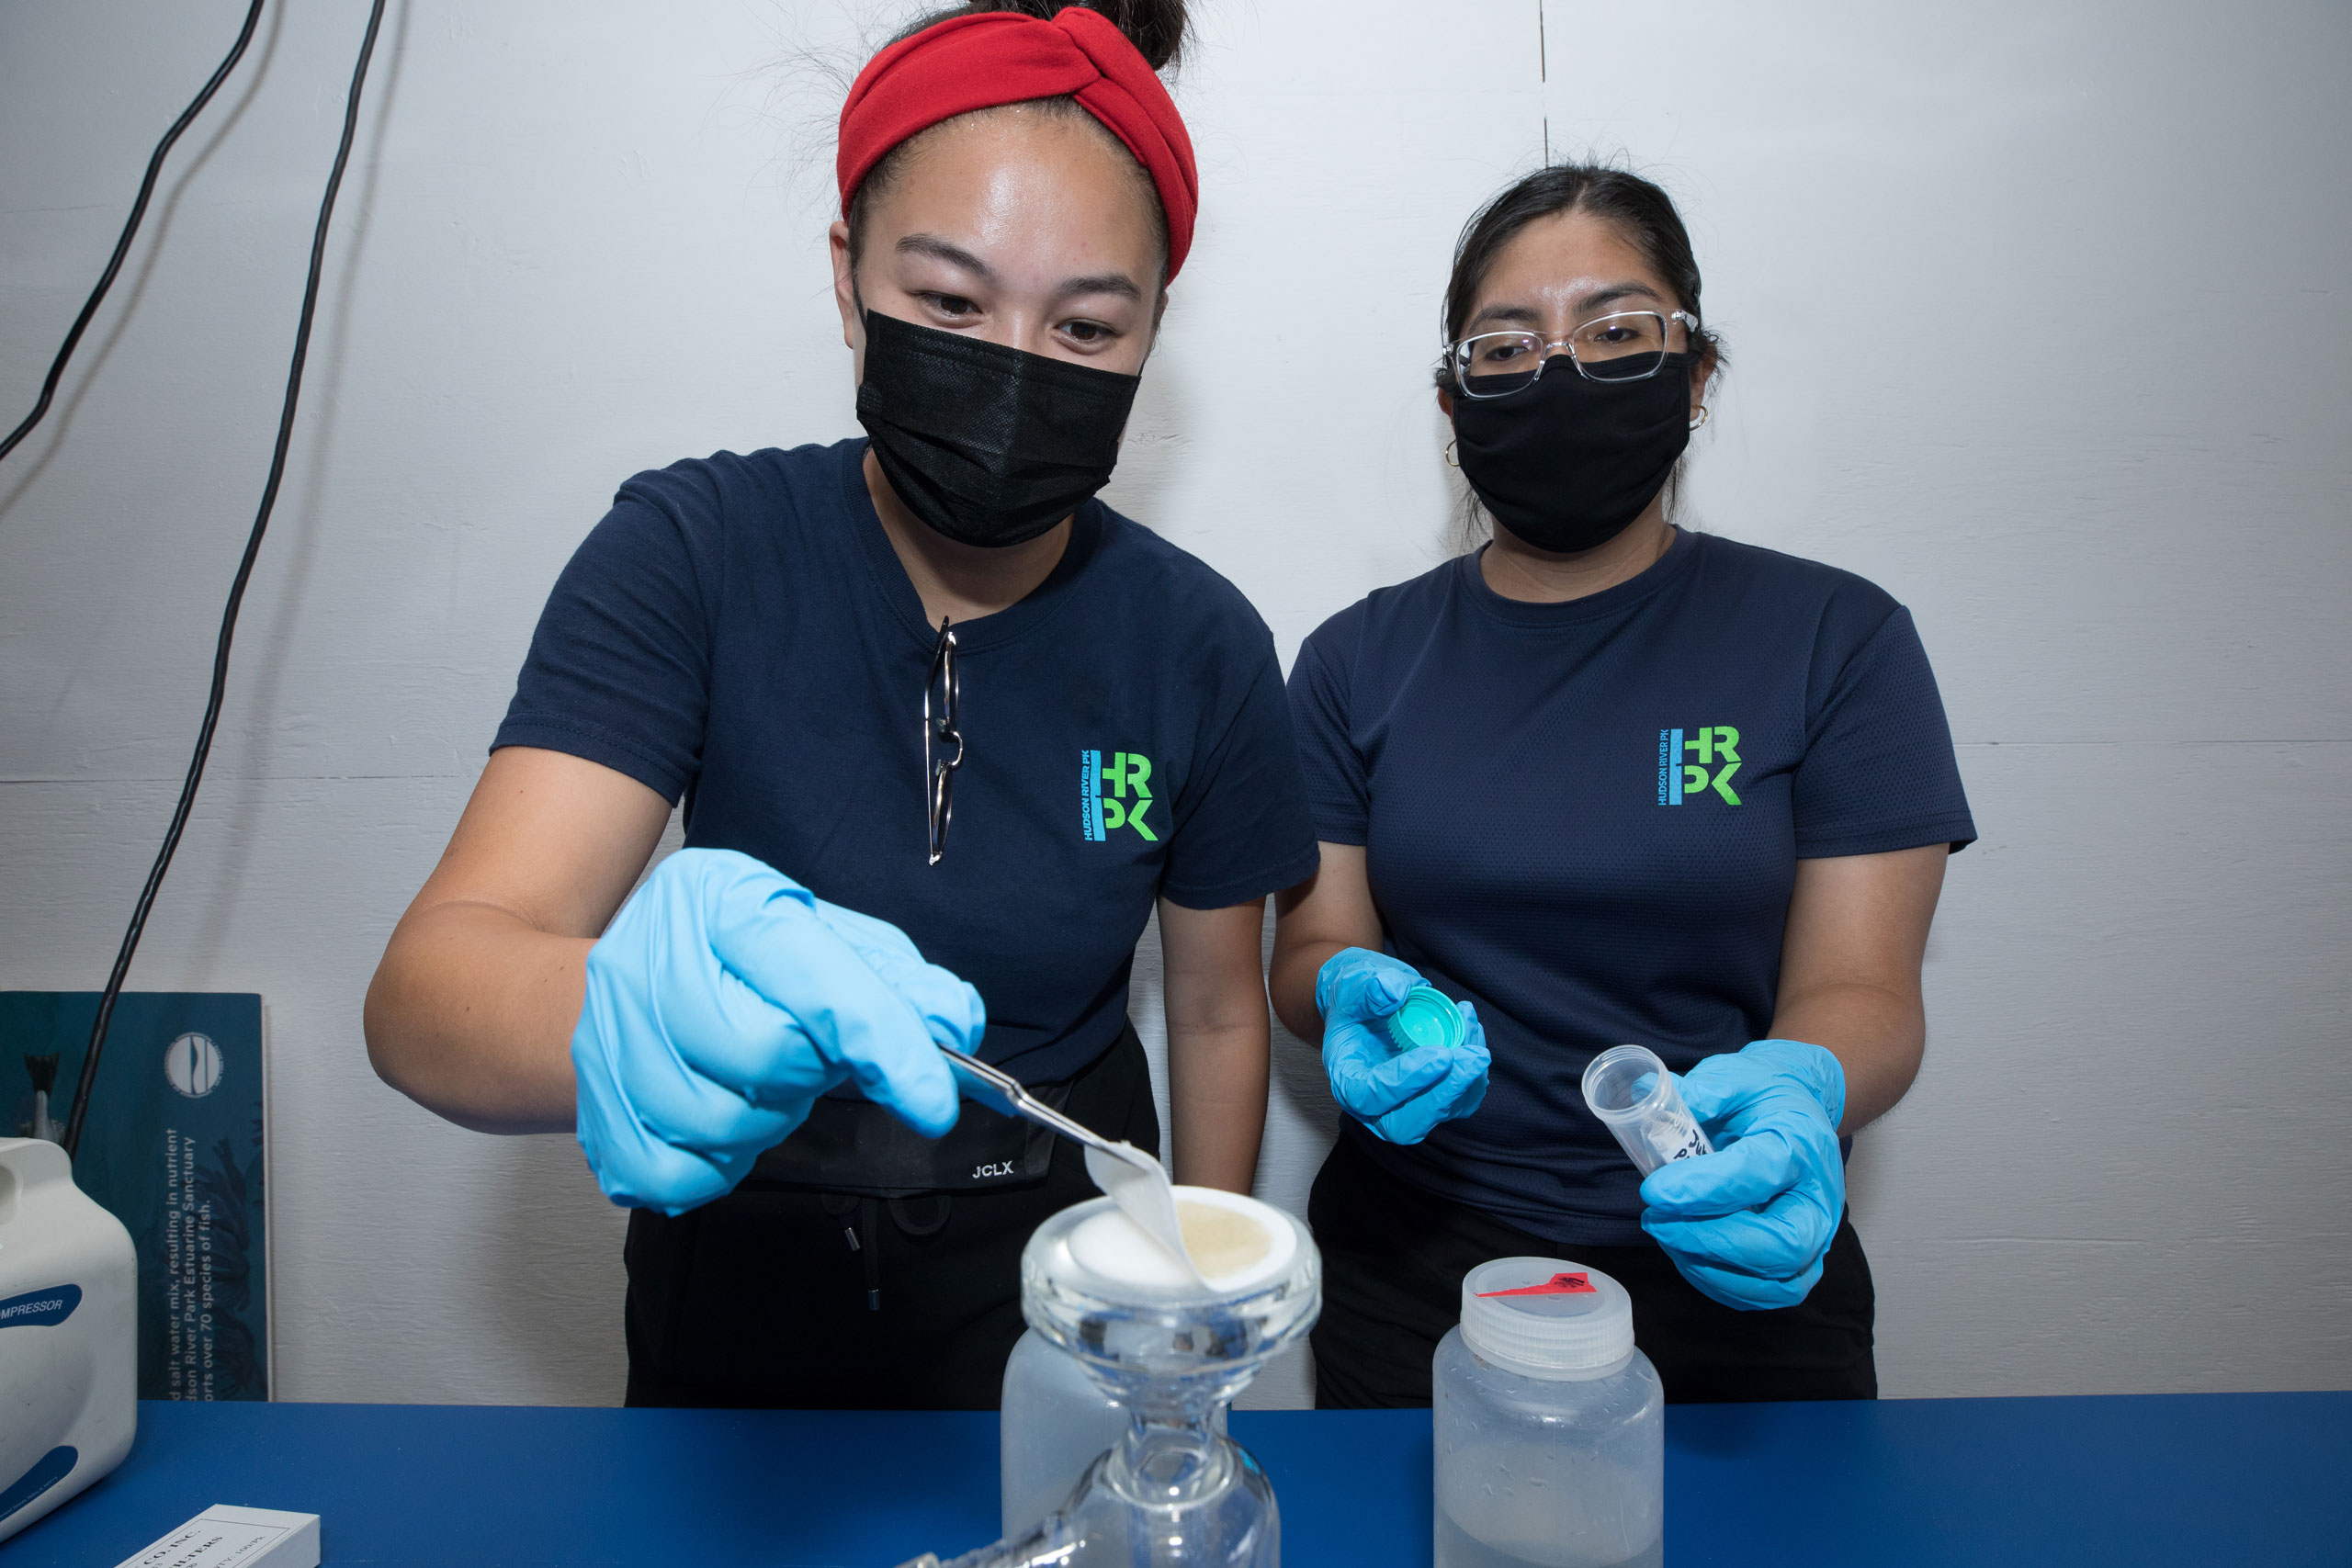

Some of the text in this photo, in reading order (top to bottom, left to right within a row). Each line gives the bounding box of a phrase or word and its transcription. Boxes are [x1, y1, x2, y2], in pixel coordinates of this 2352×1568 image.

[1657, 728, 1669, 806] HUDSON RIVER PK
[1081, 750, 1092, 841] HUDSON RIVER PK
[164, 1128, 177, 1188] nutrient
[972, 1160, 1014, 1179] JCLX
[165, 1192, 177, 1206] in
[165, 1211, 181, 1275] resulting
[182, 1136, 198, 1402] dson River Park Estuarine Sanctuary
[0, 1299, 63, 1320] MPRESSOR
[167, 1280, 180, 1310] mix,
[198, 1200, 214, 1402] orts over 70 species of fish.
[168, 1314, 180, 1356] water
[168, 1360, 180, 1388] salt
